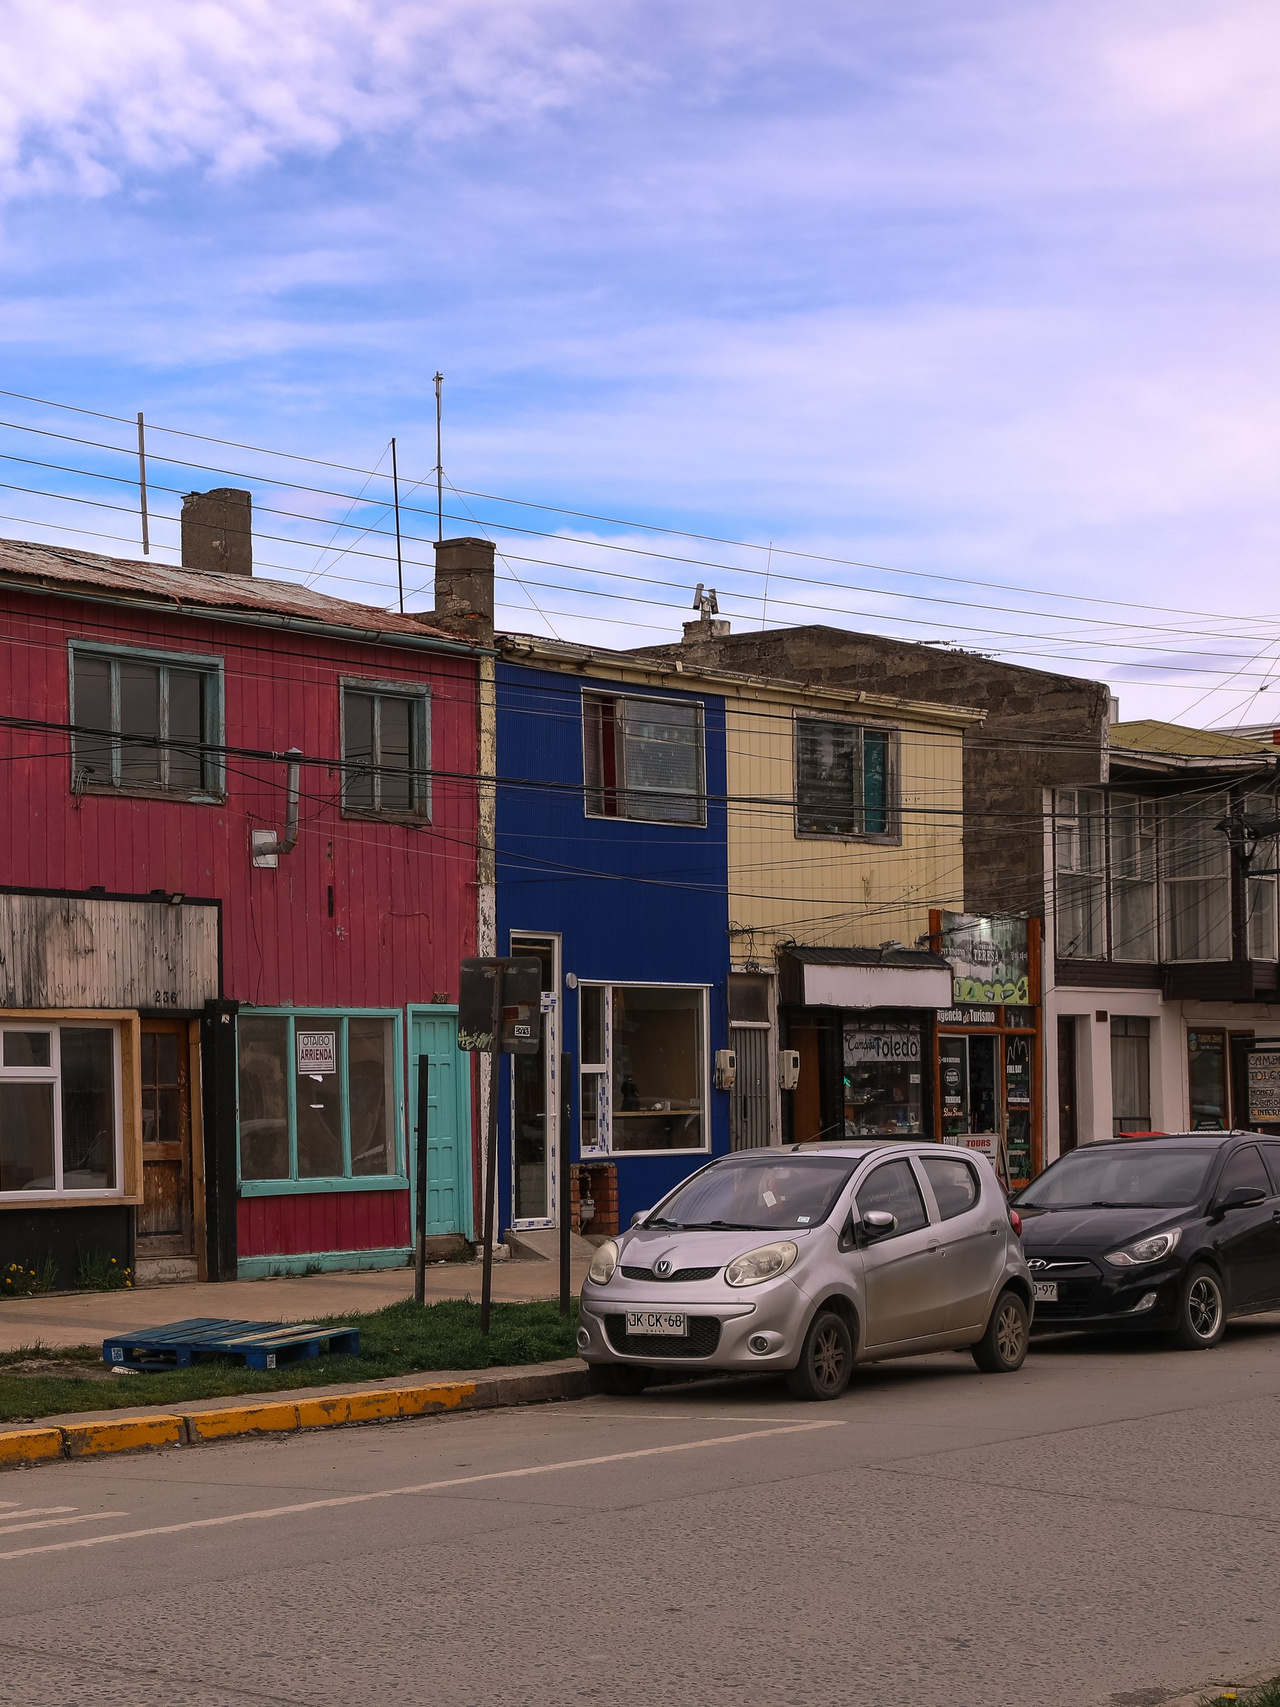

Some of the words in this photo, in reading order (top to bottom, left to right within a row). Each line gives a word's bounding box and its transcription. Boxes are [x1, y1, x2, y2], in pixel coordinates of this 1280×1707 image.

[974, 950, 999, 962] TERESA
[155, 990, 177, 1003] 236
[962, 1011, 970, 1024] de
[970, 1009, 995, 1022] Turismo
[874, 1036, 918, 1057] Toledo
[301, 1049, 332, 1060] ARRIENDA
